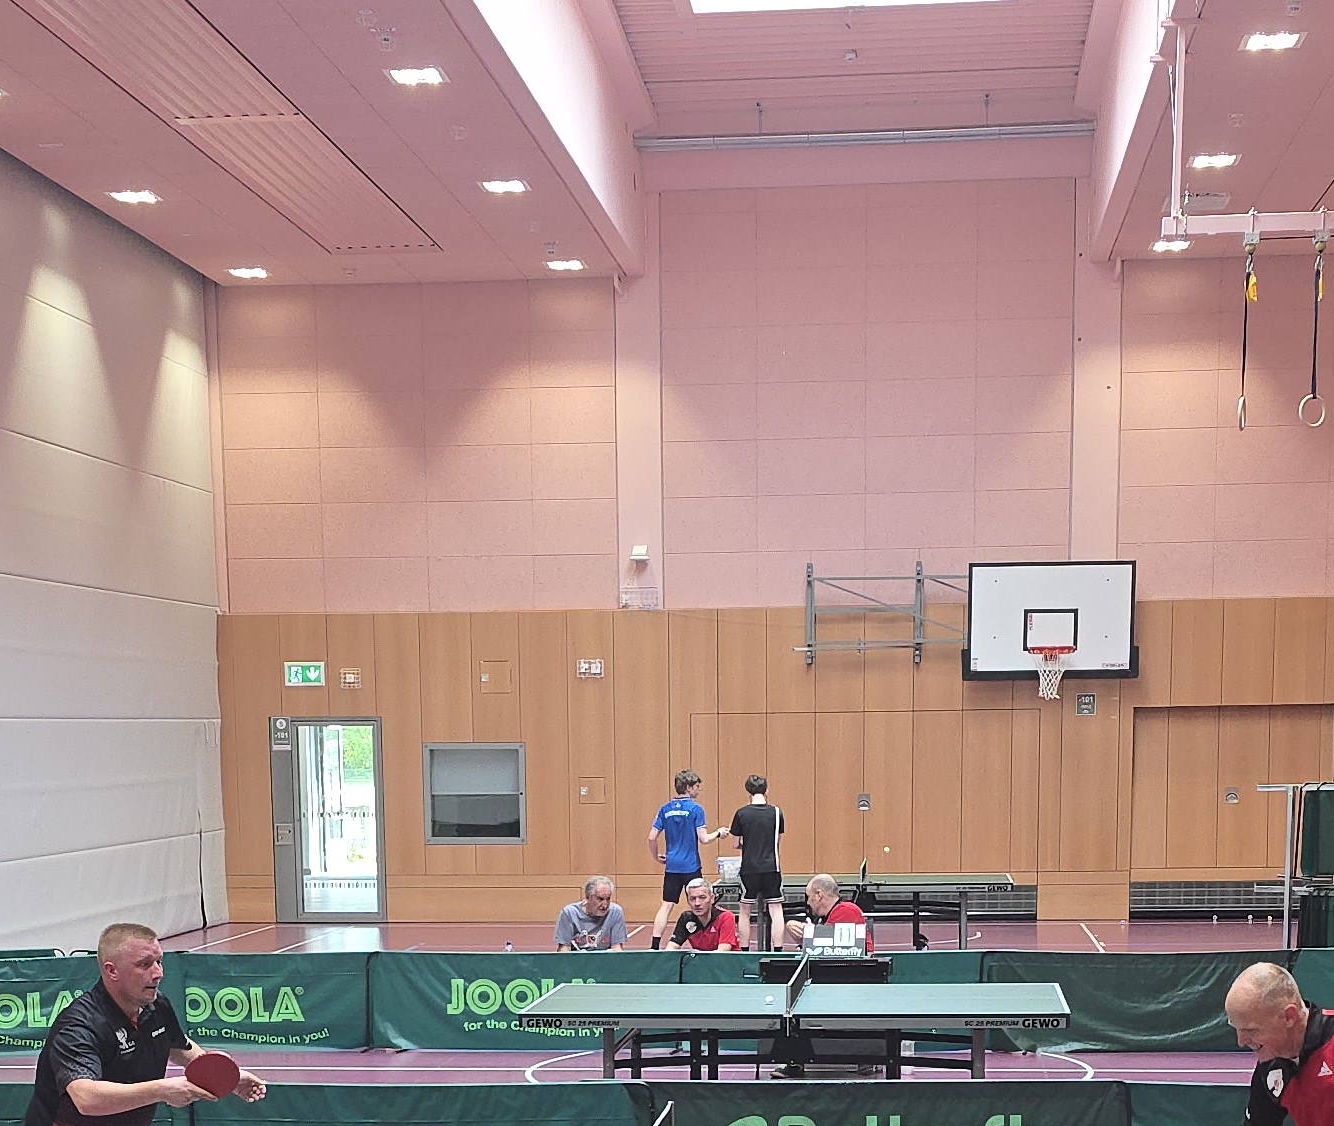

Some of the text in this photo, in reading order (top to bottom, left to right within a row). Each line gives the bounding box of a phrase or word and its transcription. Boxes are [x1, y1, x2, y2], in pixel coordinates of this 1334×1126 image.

[823, 946, 863, 957] Butterfly
[463, 1020, 483, 1031] for
[486, 1018, 508, 1030] the
[526, 1018, 563, 1028] GEWO
[1022, 1018, 1060, 1028] GEWO
[196, 1027, 218, 1038] the
[221, 1028, 286, 1044] Champion
[289, 1034, 301, 1044] in
[304, 1027, 331, 1044] you!
